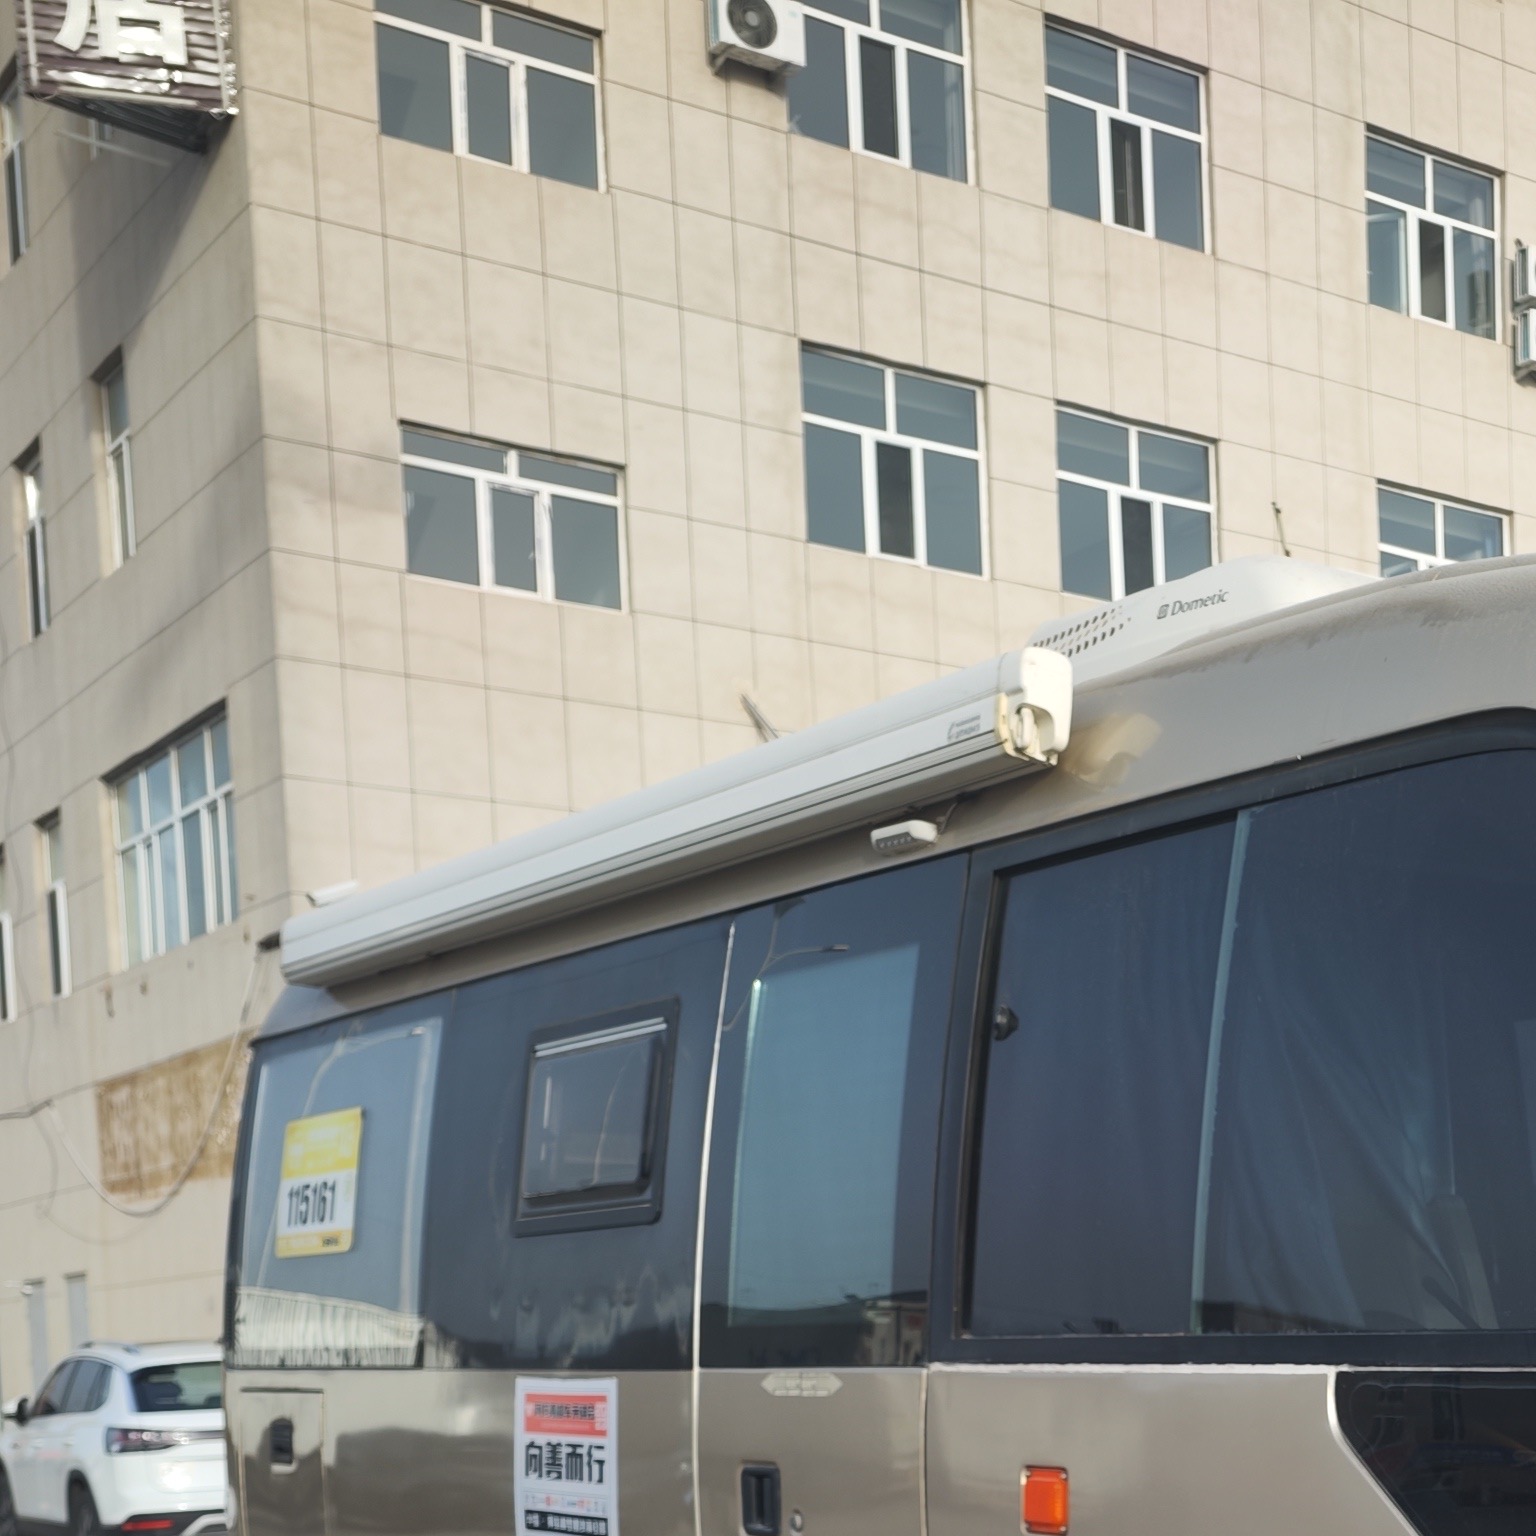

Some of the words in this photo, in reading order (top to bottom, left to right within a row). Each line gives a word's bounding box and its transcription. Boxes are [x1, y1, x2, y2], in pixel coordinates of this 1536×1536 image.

[1170, 588, 1229, 616] Dometic
[287, 1180, 337, 1228] 115161
[524, 1441, 606, 1484] 向善而行
